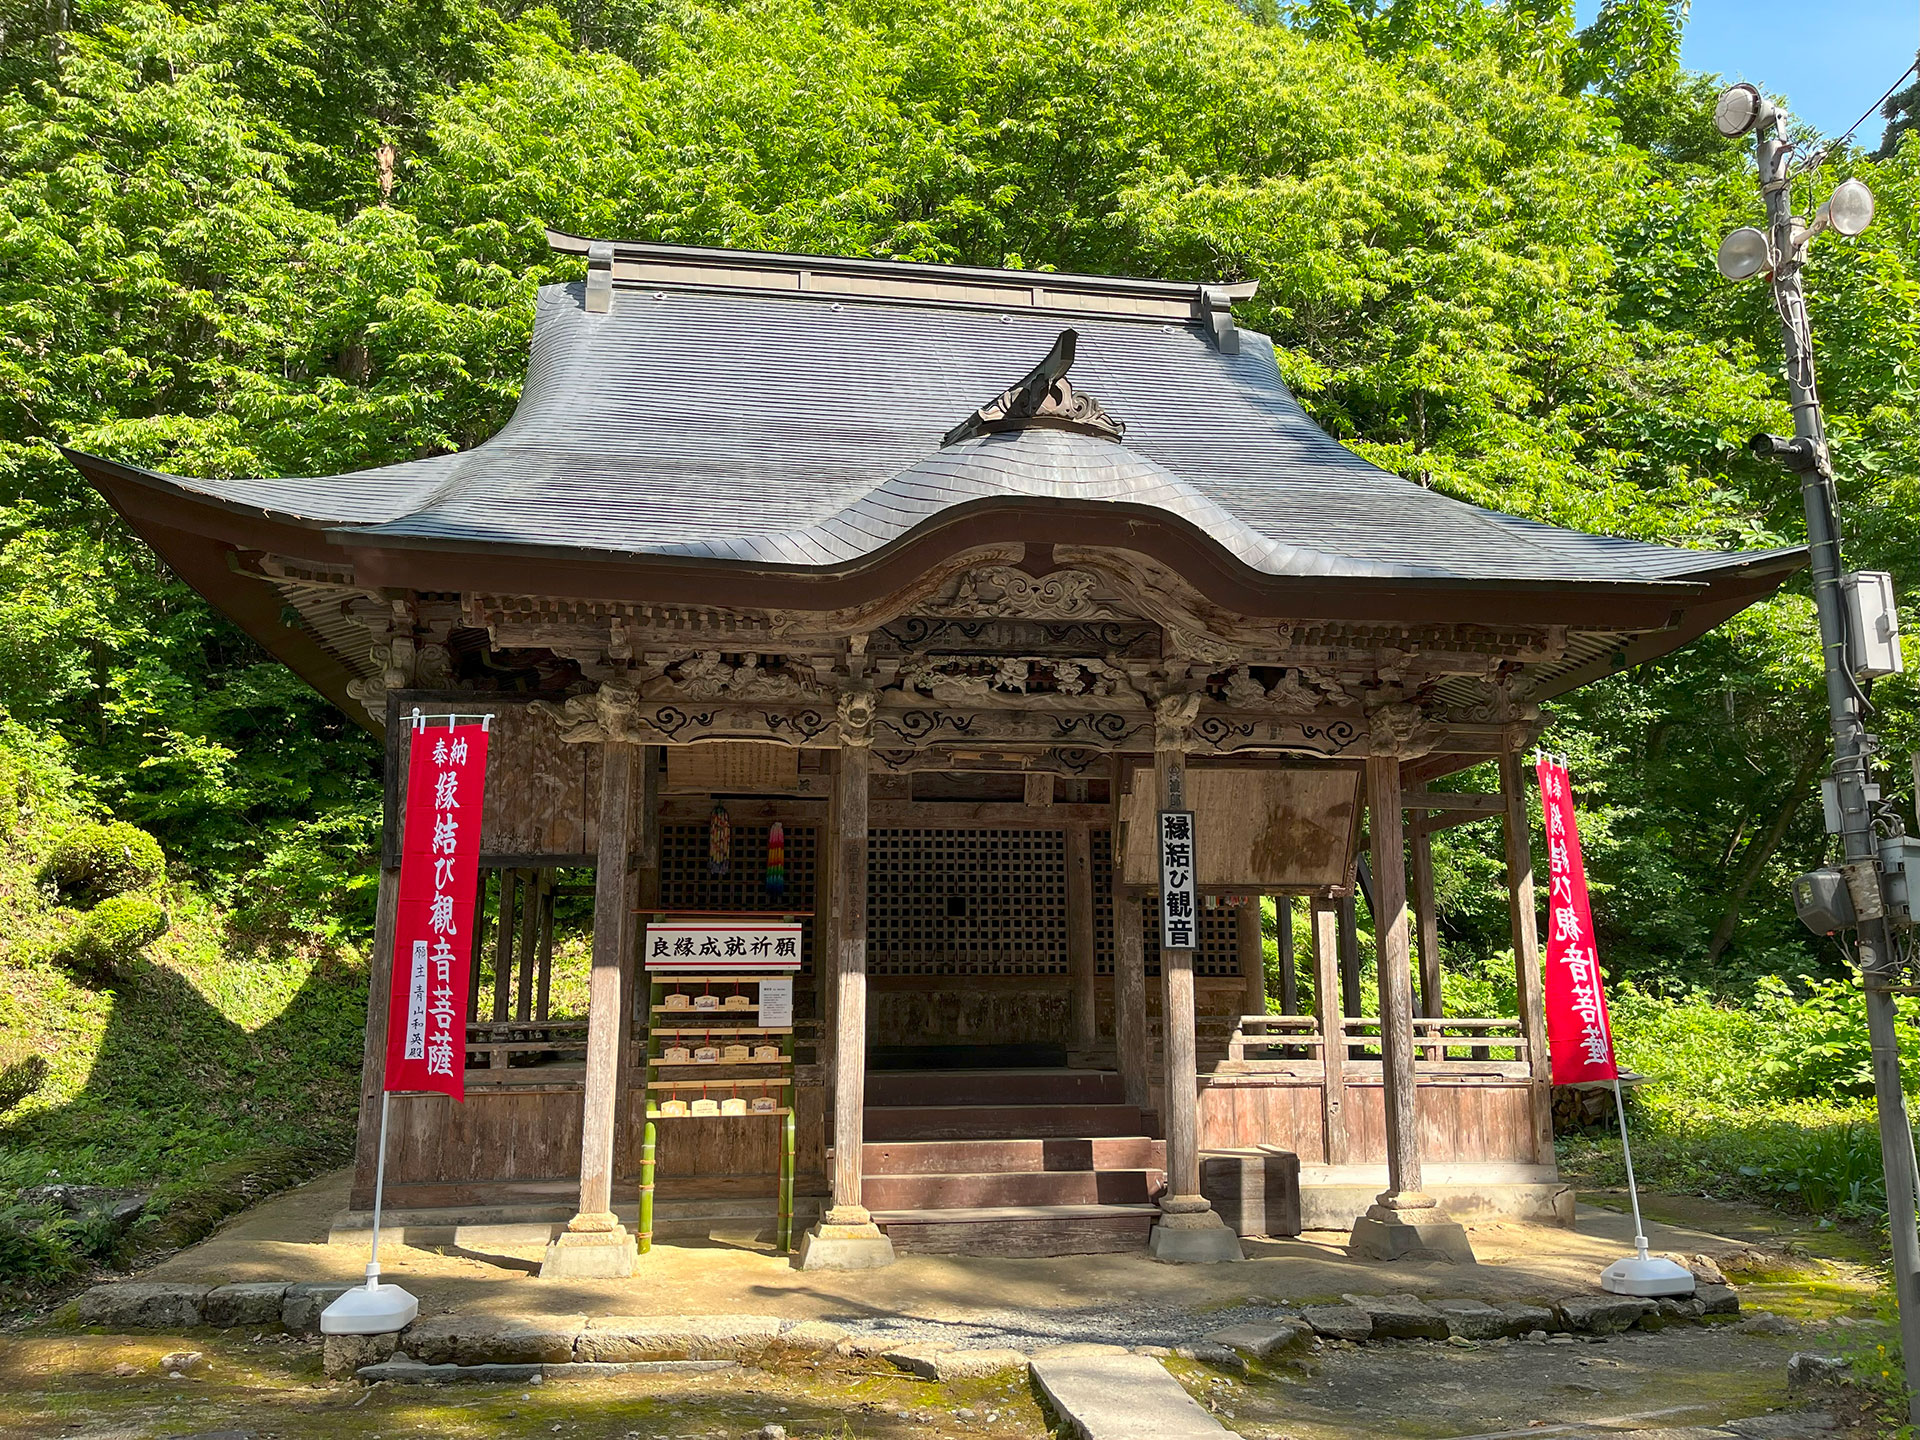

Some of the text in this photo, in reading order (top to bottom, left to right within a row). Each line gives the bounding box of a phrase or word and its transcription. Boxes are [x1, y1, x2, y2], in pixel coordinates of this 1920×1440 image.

[432, 737, 468, 767] 奉納
[1164, 815, 1193, 946] 縁結び観音
[427, 771, 460, 1077] 縁結び観音菩薩
[651, 936, 797, 958] 良縁成就祈願
